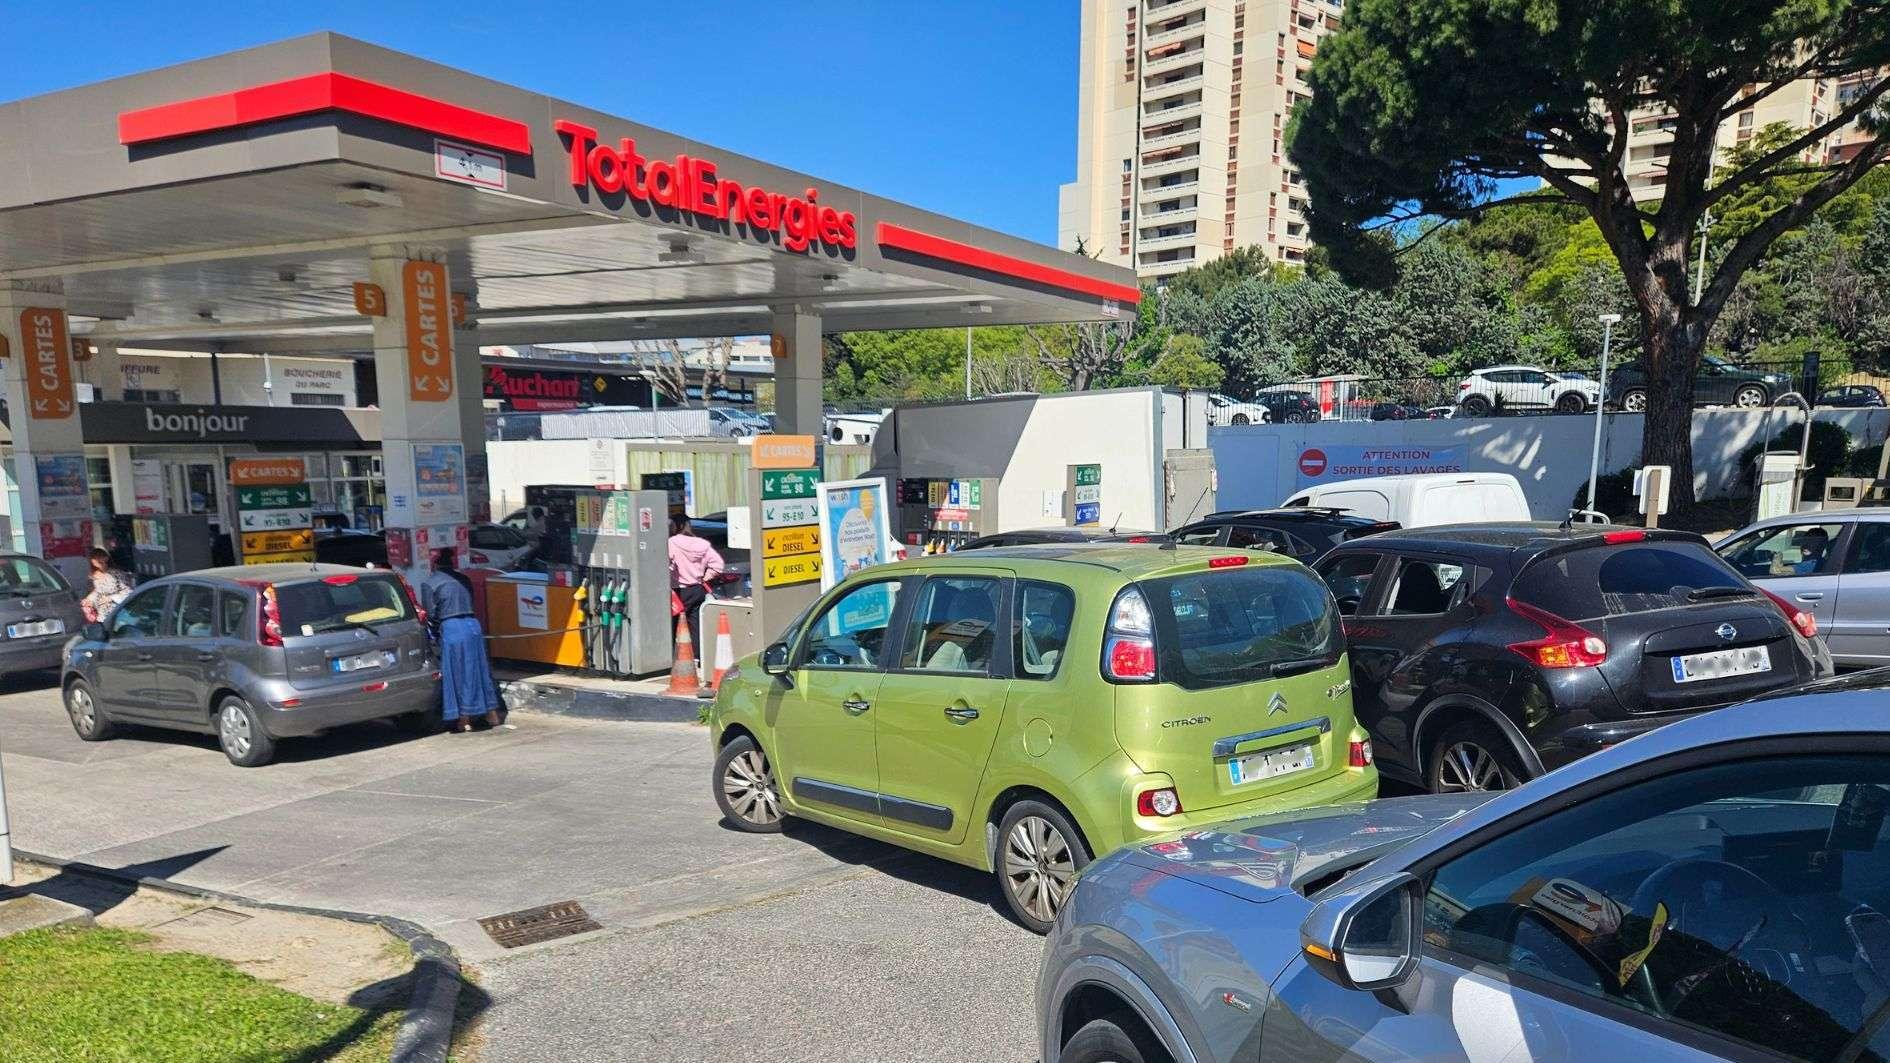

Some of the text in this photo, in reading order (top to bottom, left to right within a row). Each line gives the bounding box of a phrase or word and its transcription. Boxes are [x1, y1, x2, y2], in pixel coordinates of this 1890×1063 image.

[554, 119, 857, 252] TotalEnergies
[364, 288, 376, 309] 5
[415, 270, 440, 366] CARTES
[34, 315, 59, 391] CARTES
[120, 364, 161, 375] IFFURE
[485, 367, 580, 397] Auchan
[145, 407, 249, 438] bonjour
[1362, 450, 1430, 460] ATTENTION
[250, 467, 289, 477] CARTES
[1333, 464, 1461, 475] SORTIE DES LAVAGES
[782, 543, 804, 552] DIESEL
[784, 564, 805, 575] DIESEL
